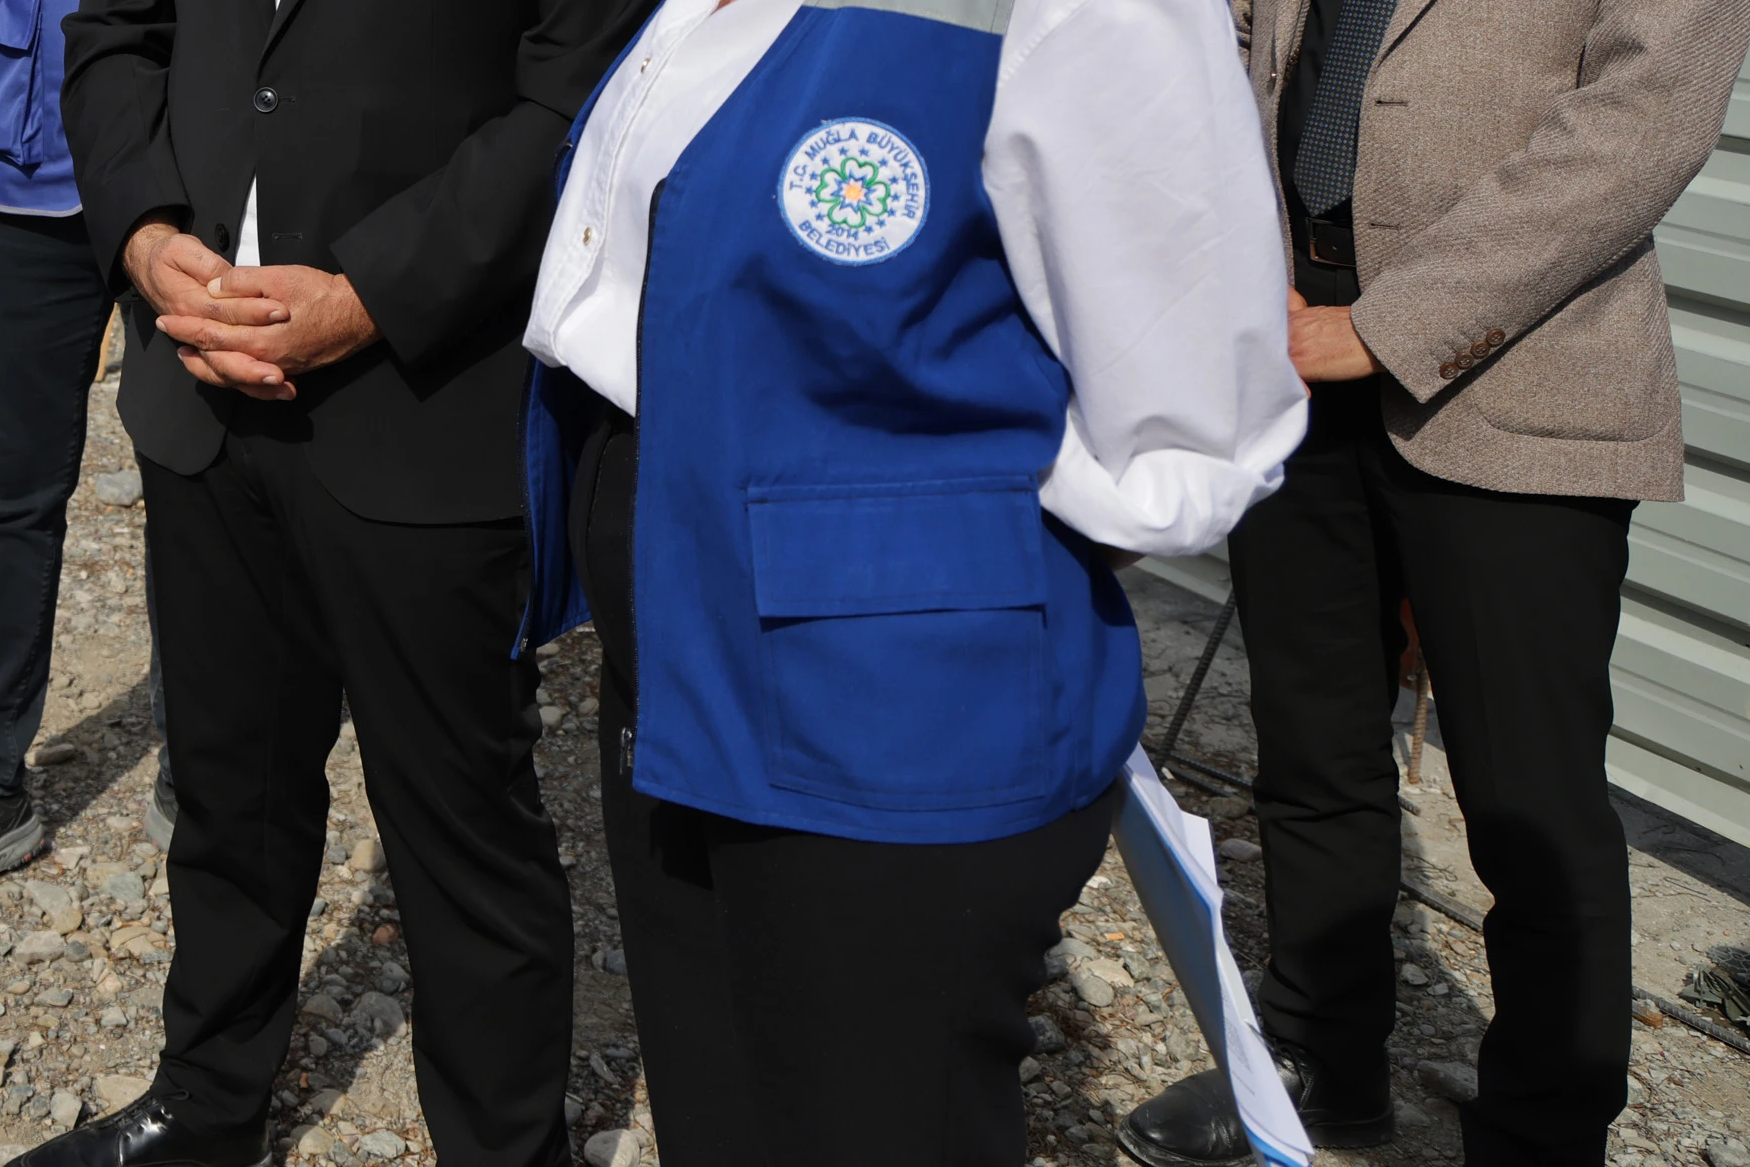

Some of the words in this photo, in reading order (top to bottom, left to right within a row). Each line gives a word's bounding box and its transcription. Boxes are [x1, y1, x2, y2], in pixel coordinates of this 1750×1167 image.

[804, 128, 859, 161] MUĞLA
[866, 131, 920, 220] BÜYÜKŞEHİR
[798, 219, 891, 257] BELEDİYESİ
[825, 224, 860, 241] 2014
